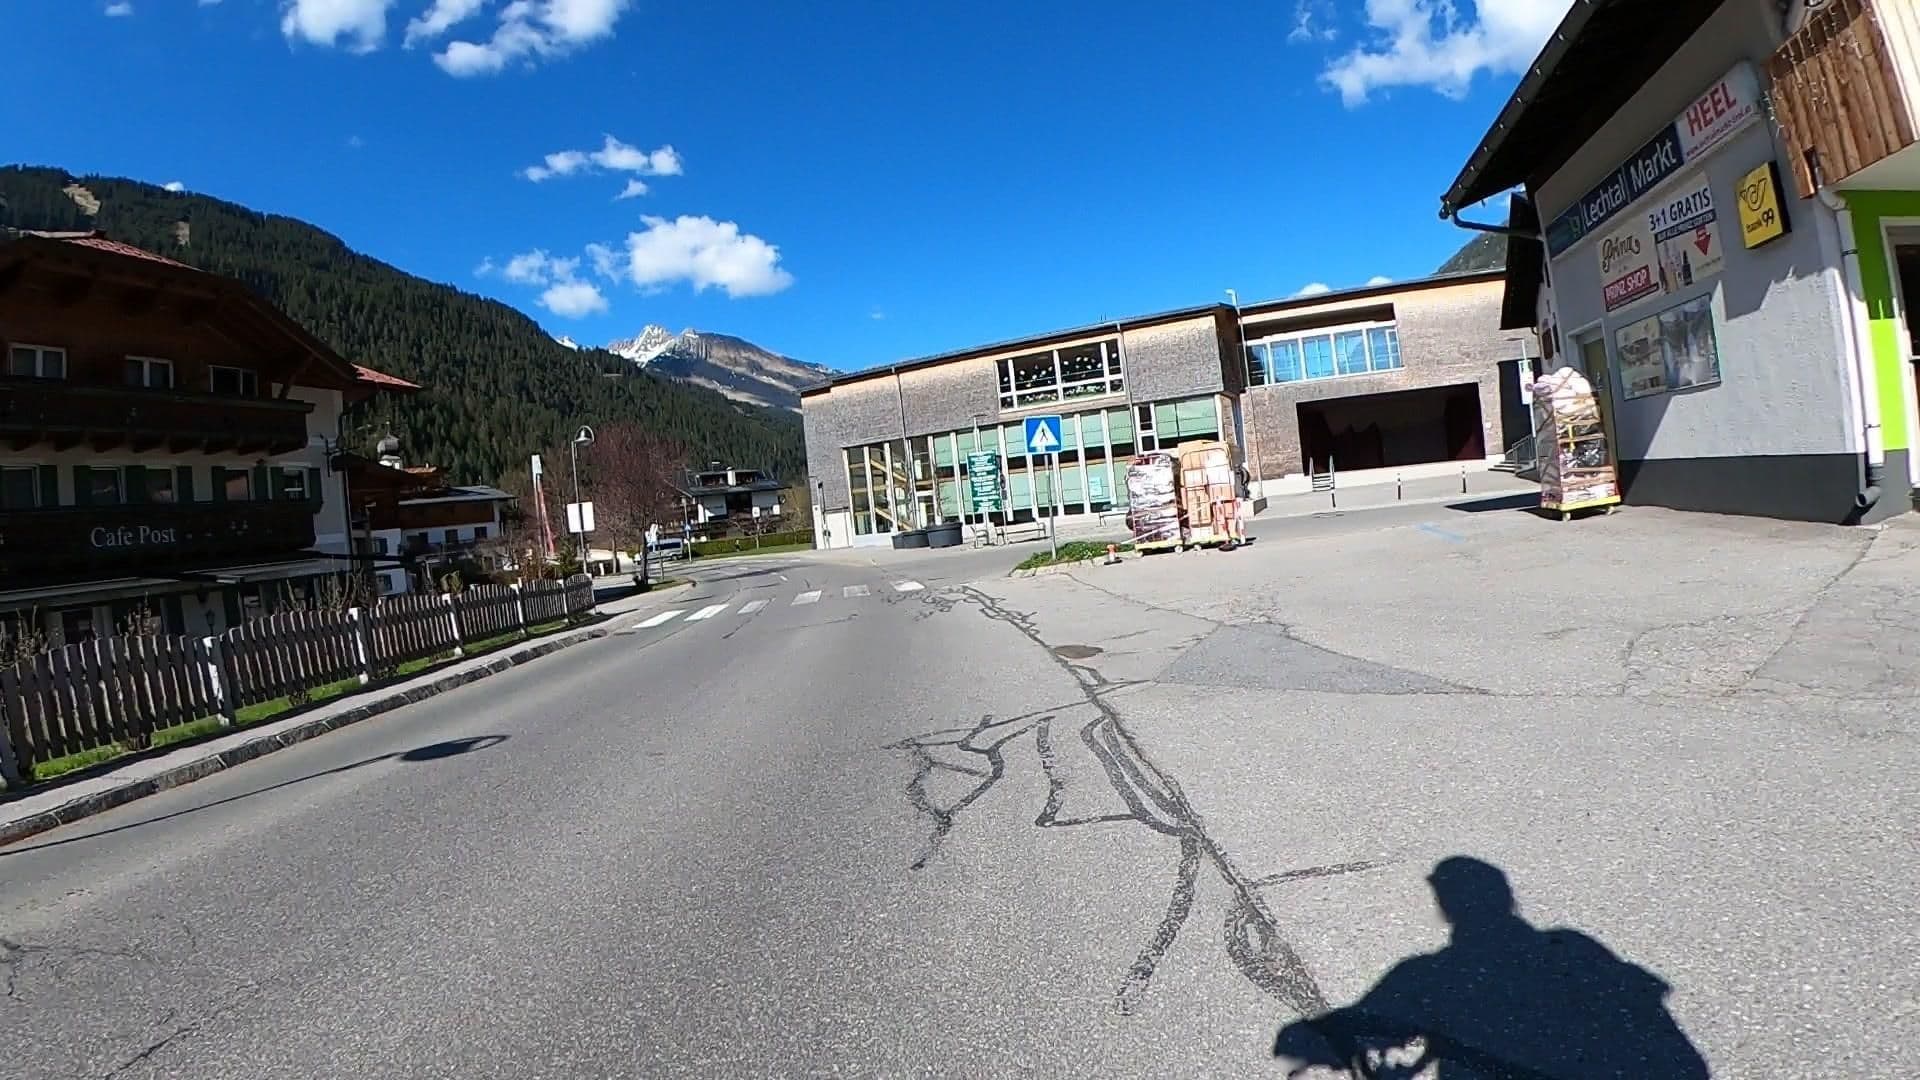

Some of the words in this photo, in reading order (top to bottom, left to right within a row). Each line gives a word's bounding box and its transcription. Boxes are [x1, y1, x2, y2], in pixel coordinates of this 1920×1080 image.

[1687, 82, 1737, 137] HEEL
[1582, 173, 1627, 228] Lechtal
[1630, 138, 1677, 193] Markt
[1649, 207, 1668, 231] 3+1
[1669, 187, 1711, 222] GRATIS
[1762, 207, 1775, 228] 99
[1602, 233, 1641, 273] Prinz
[1627, 268, 1647, 291] SHOP
[90, 526, 133, 549] Cafe
[139, 525, 177, 545] Post
